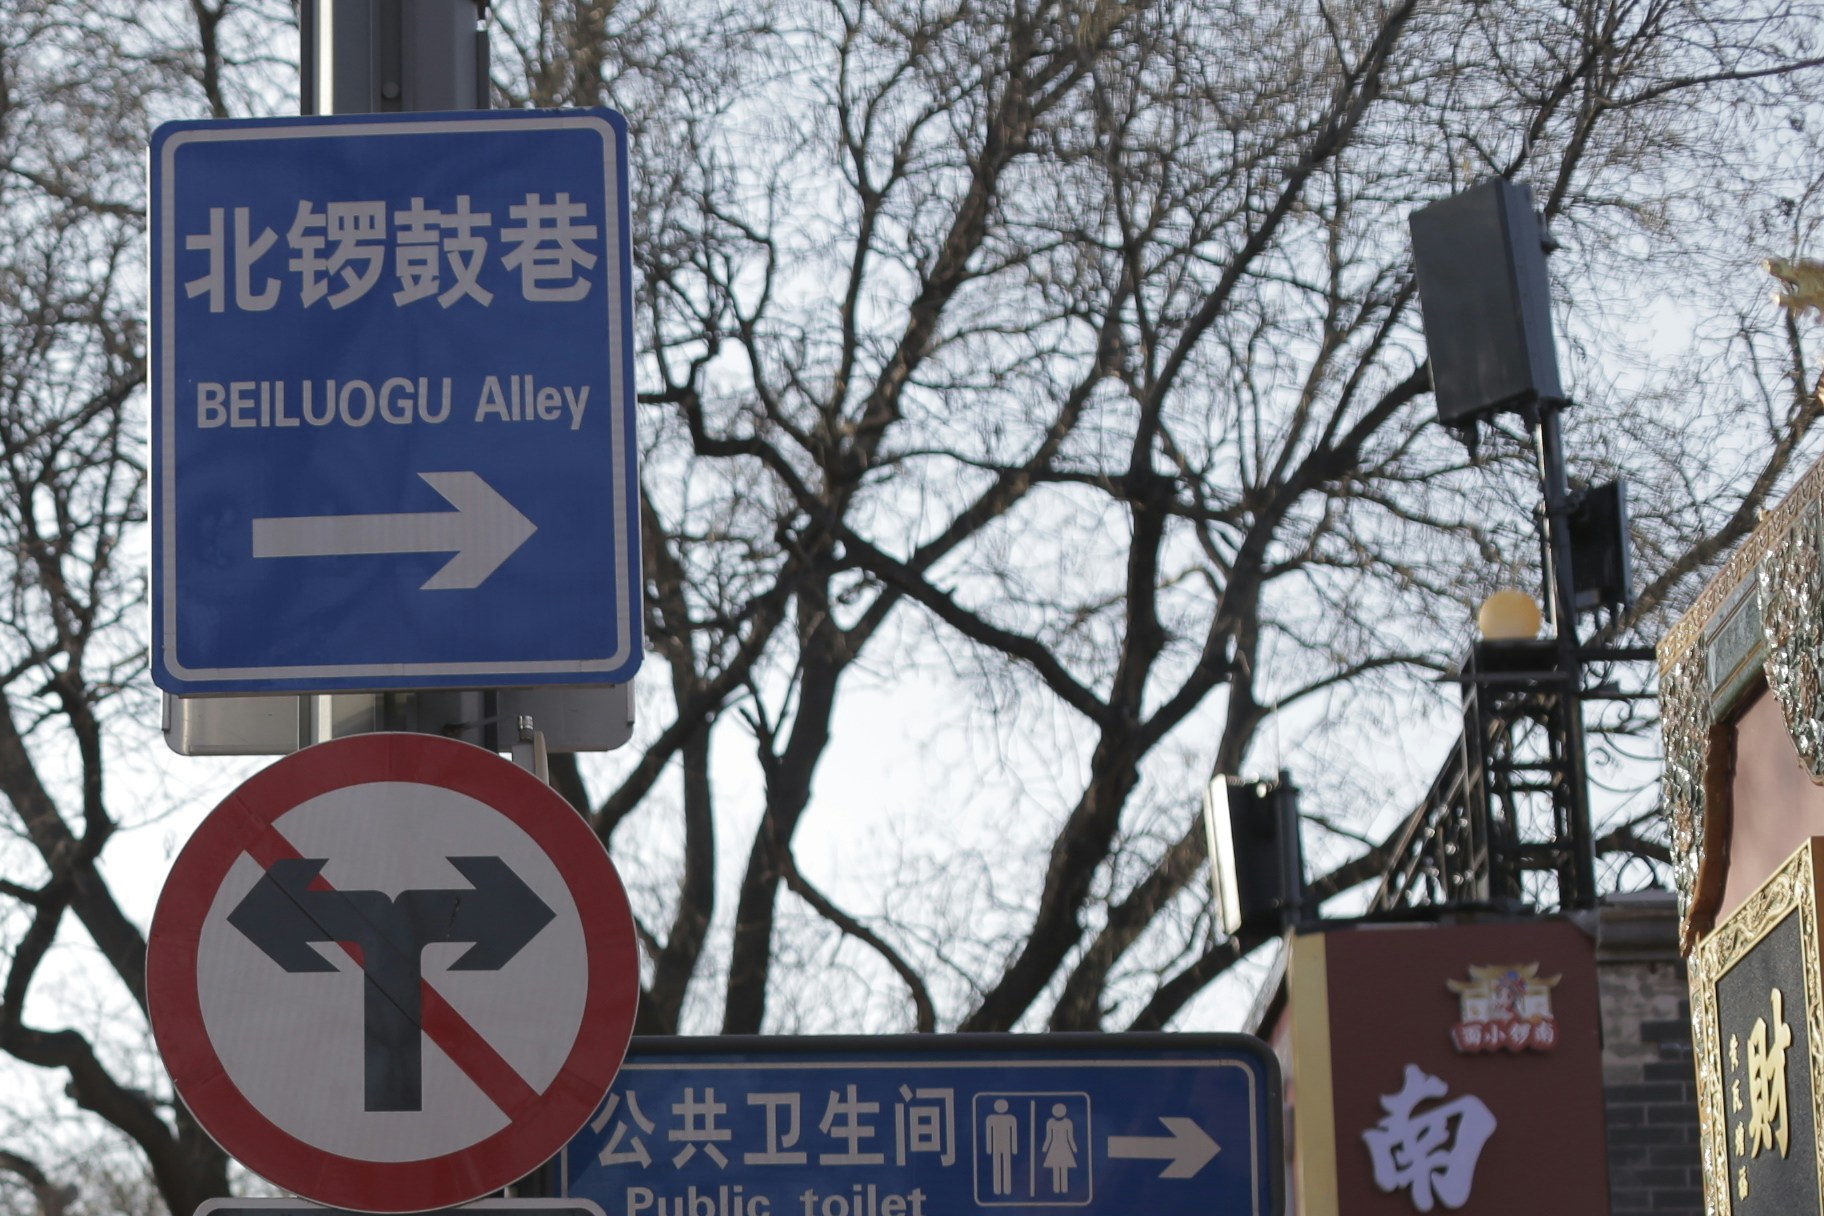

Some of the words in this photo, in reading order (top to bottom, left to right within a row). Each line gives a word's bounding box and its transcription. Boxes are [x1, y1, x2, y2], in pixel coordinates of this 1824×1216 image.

[185, 192, 598, 313] 北锣鼓巷
[197, 377, 452, 429] BEILUOGU
[475, 374, 591, 431] Alley
[590, 1083, 957, 1169] 公共卫生间
